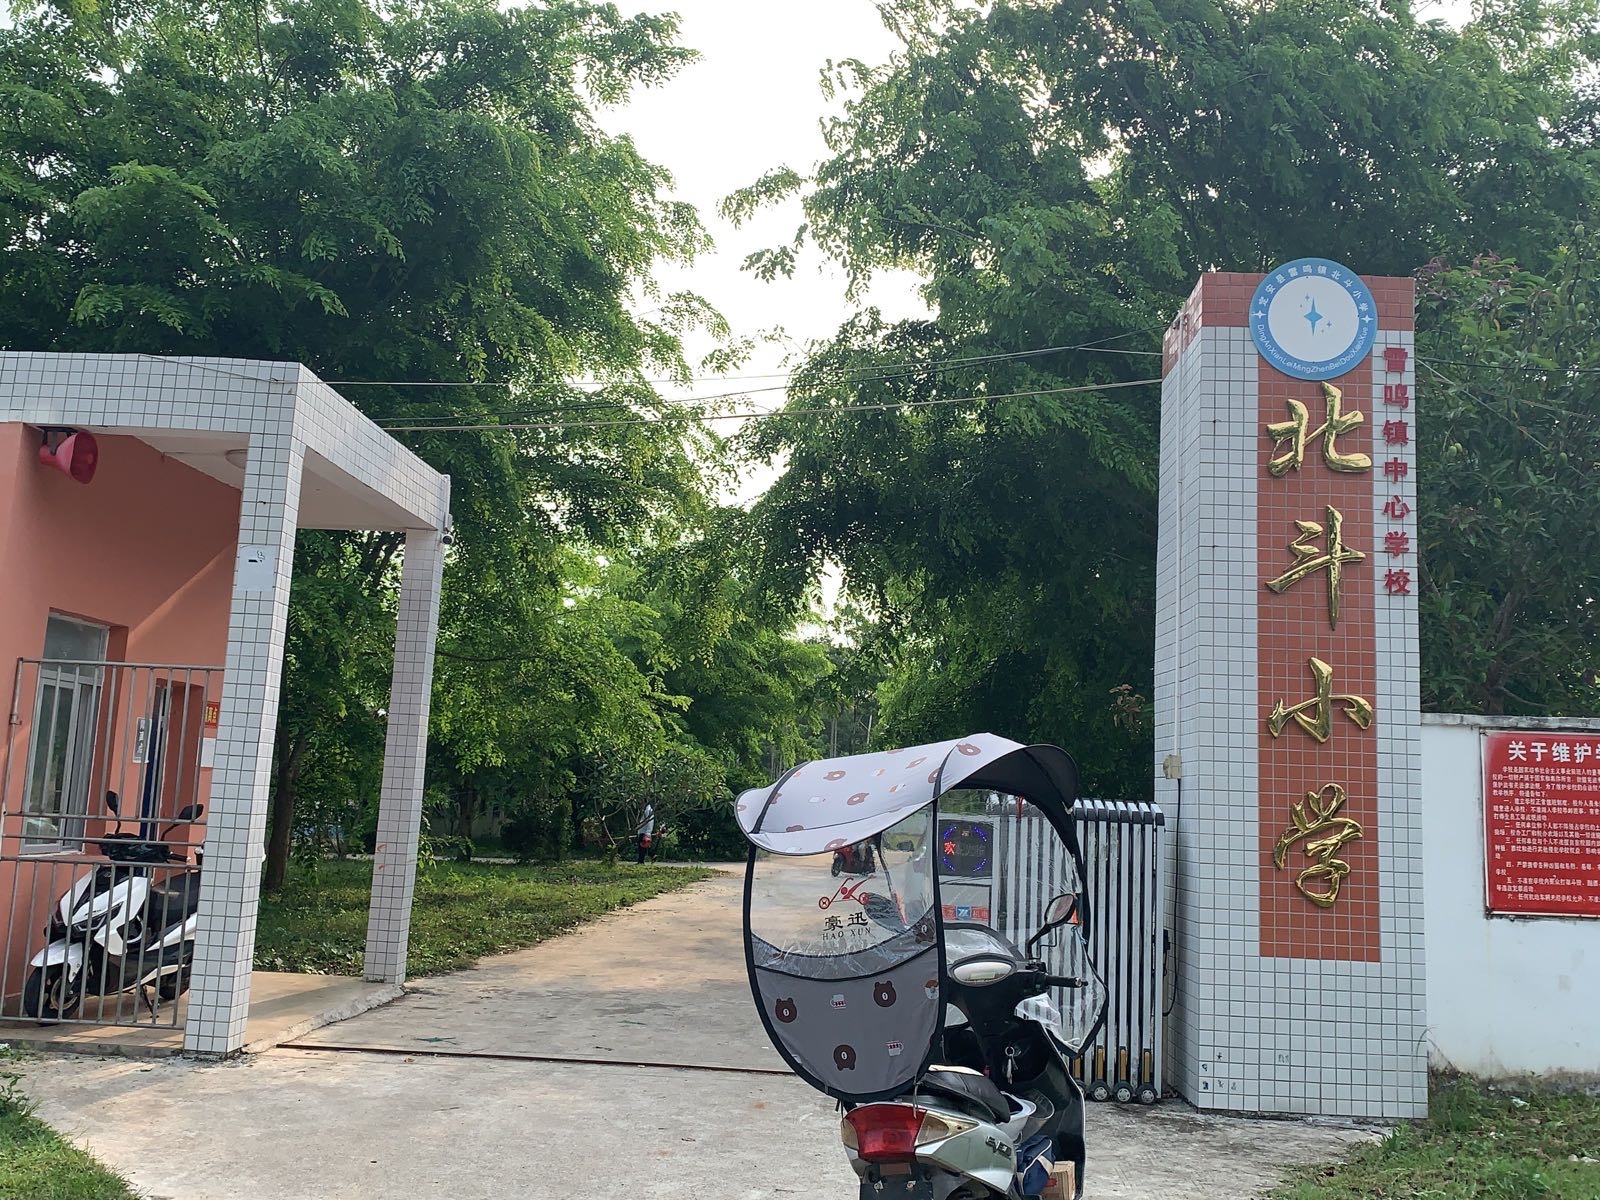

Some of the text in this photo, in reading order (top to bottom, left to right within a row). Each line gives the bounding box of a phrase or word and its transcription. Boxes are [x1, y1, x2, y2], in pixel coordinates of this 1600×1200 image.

[1258, 264, 1369, 312] 定安县雷鸣镇北斗小学
[1382, 347, 1411, 595] 雷鸣镇中心学校
[1265, 381, 1373, 908] 北斗小学
[1508, 741, 1600, 763] 关于维护
[822, 926, 871, 941] HAO XUN
[823, 911, 869, 931] 豪迅
